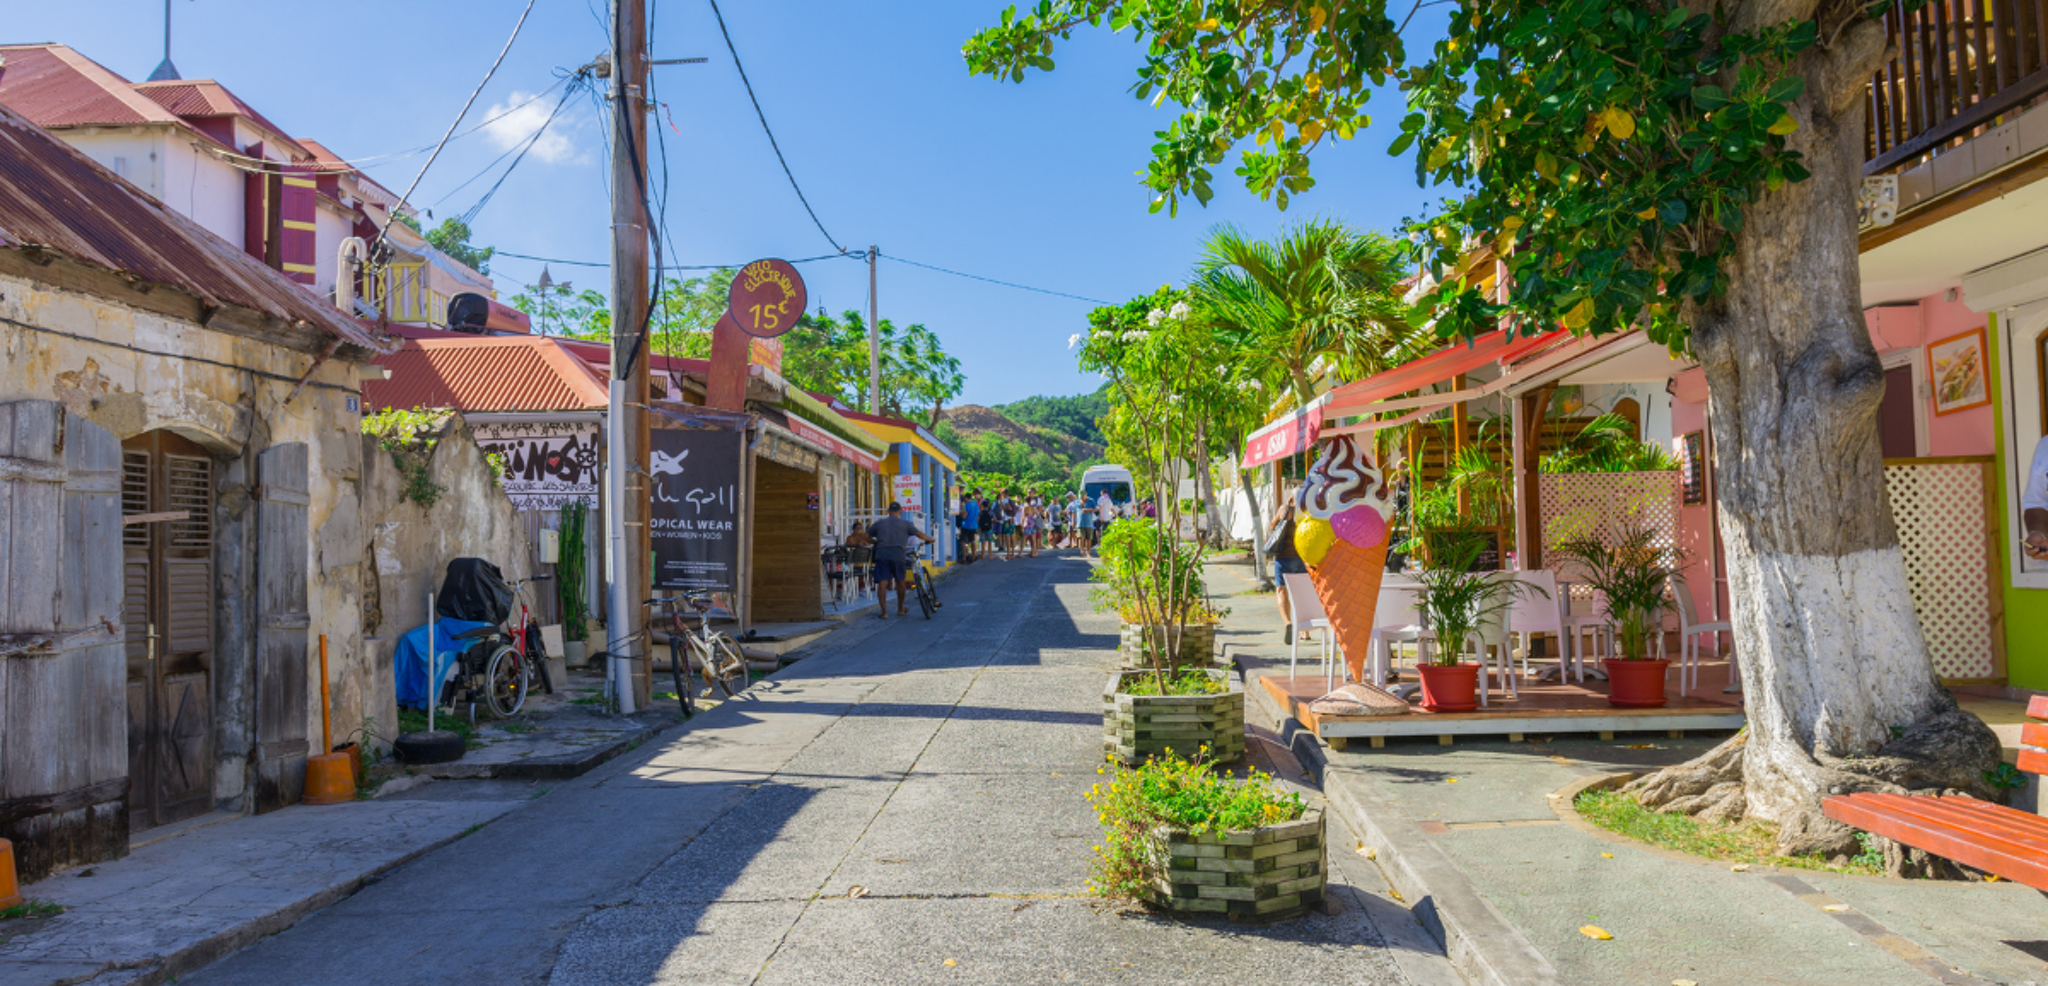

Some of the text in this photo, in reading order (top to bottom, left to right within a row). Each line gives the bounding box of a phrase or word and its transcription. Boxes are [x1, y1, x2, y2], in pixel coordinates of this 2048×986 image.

[649, 518, 733, 531] OPICAL WEAR
[650, 530, 723, 540] EN WOMEN KIDS
